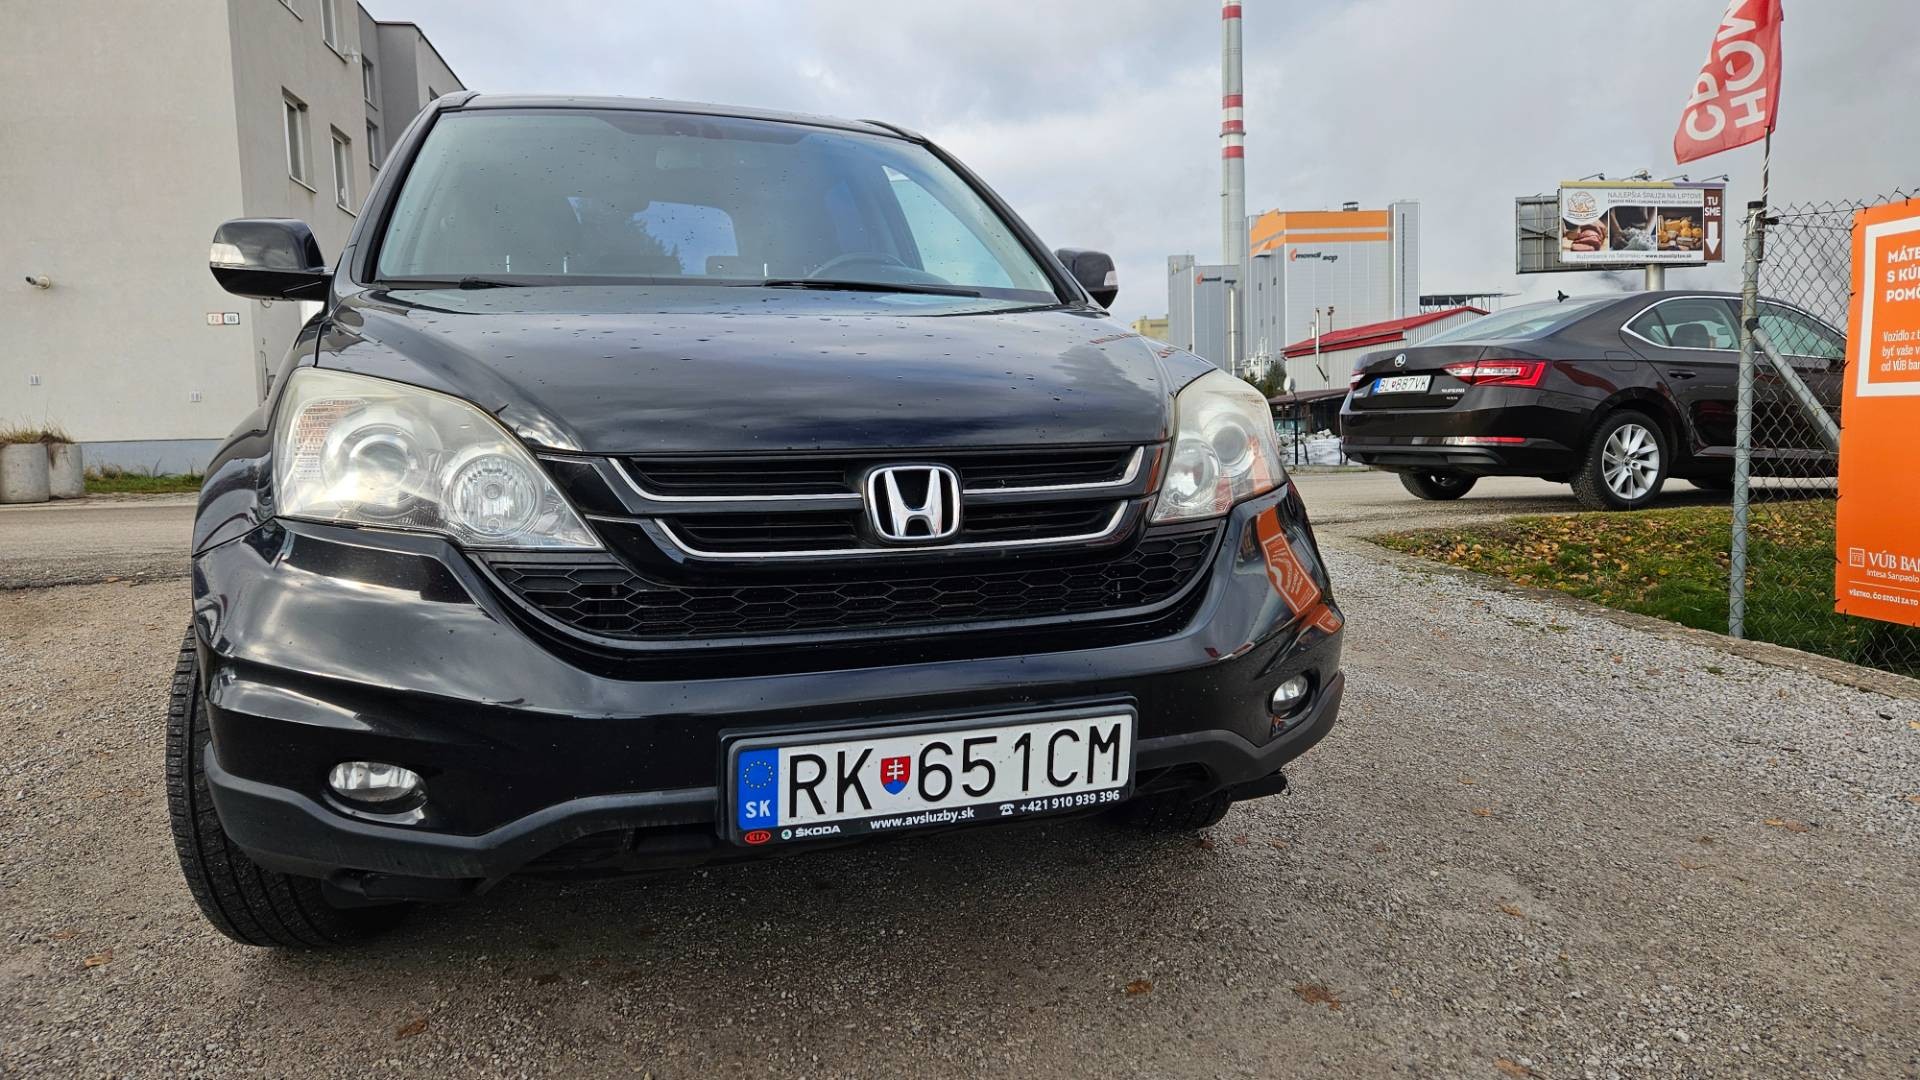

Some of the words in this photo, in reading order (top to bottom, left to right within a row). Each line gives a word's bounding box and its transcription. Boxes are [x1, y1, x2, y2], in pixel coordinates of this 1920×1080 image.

[1705, 196, 1719, 206] TU
[1704, 206, 1721, 217] SME
[1886, 269, 1896, 283] S
[1898, 263, 1920, 282] KÚ
[1883, 329, 1910, 342] Vozidlo
[1881, 359, 1891, 372] od
[1868, 550, 1897, 569] VÚB
[1866, 568, 1887, 579] Intesa
[1887, 571, 1920, 583] Sanpaolo
[788, 747, 874, 819] RK
[917, 722, 1122, 803] 651CM
[745, 799, 771, 819] SK
[1020, 799, 1048, 813] +421
[1051, 796, 1073, 809] 910
[1075, 793, 1097, 806] 939
[1099, 790, 1120, 803] 396
[870, 806, 975, 830] www.avsluzby.sk
[749, 831, 766, 841] KIA
[795, 825, 841, 838] ŠKODA
